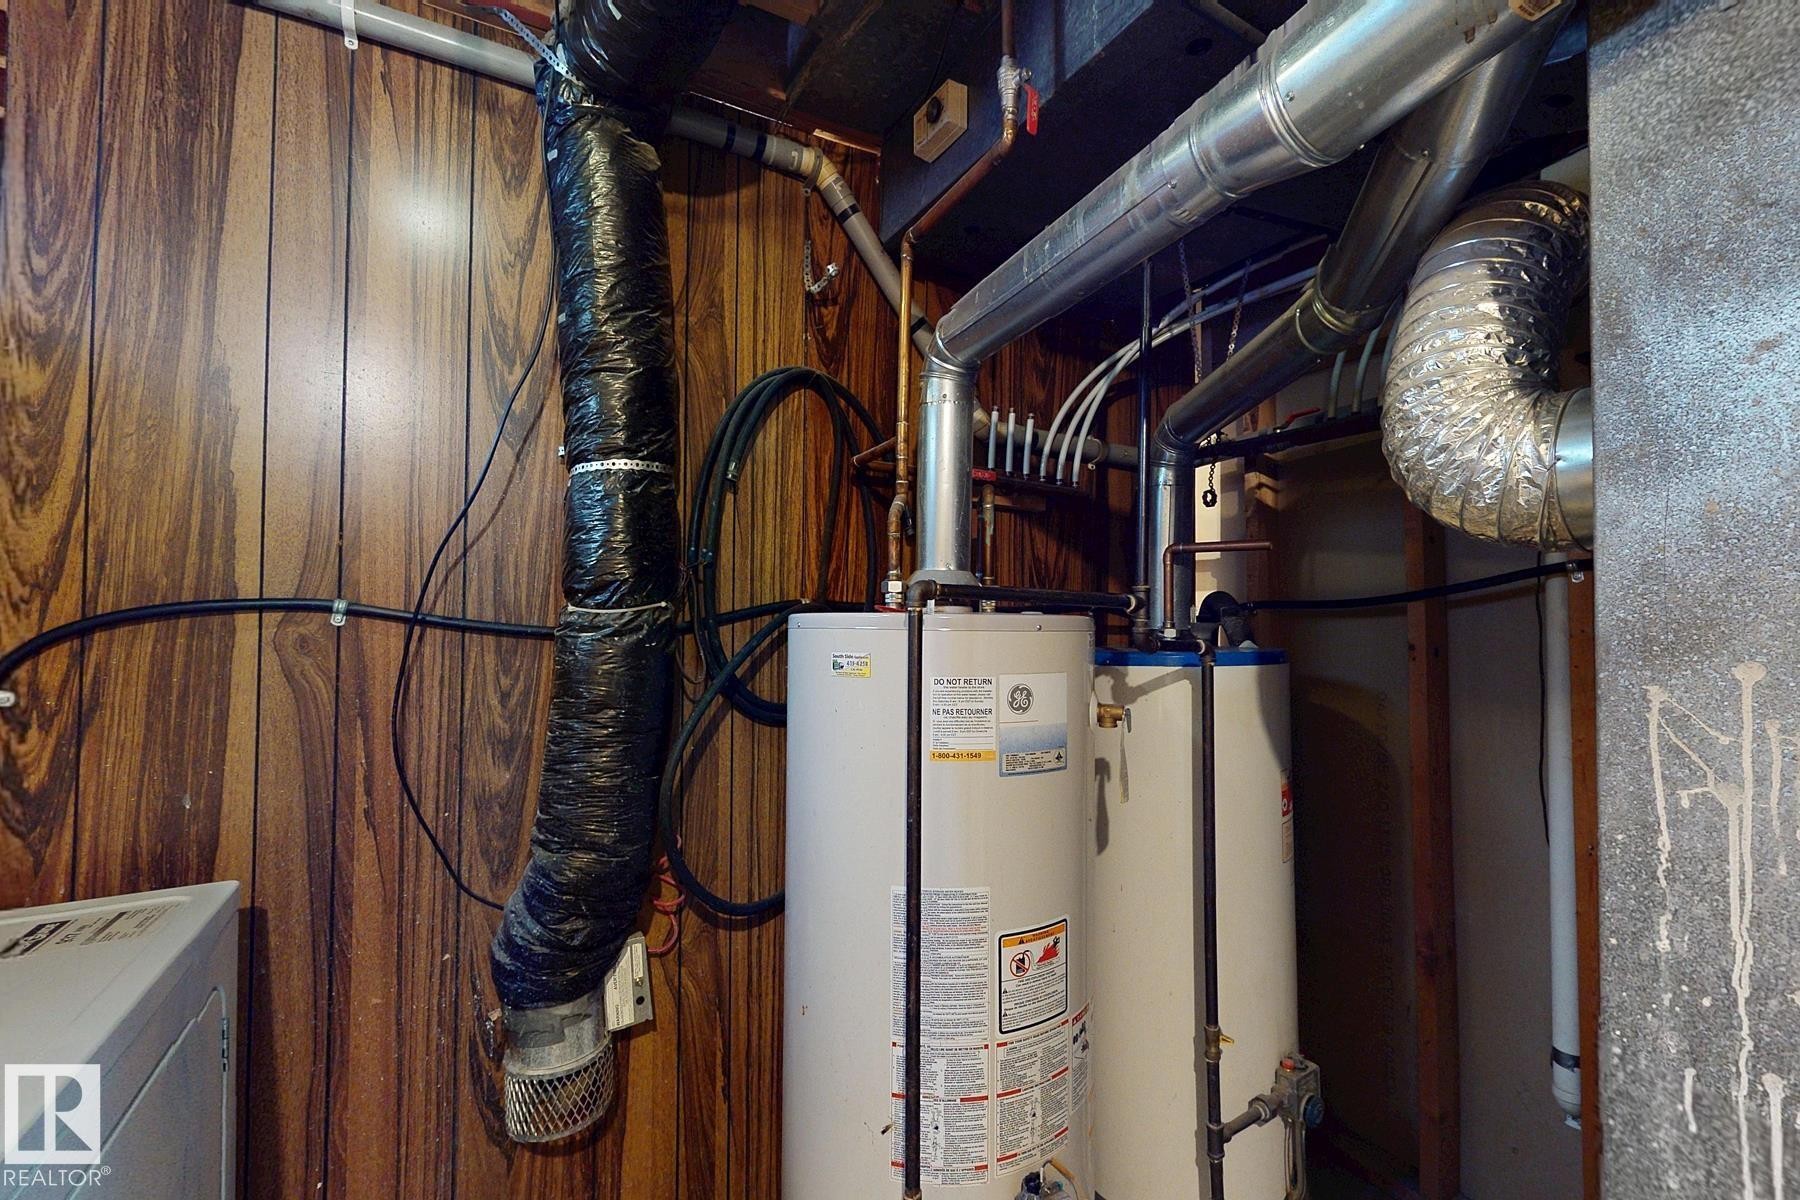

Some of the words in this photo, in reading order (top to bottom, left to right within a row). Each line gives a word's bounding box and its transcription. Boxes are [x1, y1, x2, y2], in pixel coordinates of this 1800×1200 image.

[933, 678, 945, 686] DO
[946, 678, 962, 686] NOT
[963, 678, 993, 686] RETURN
[932, 708, 941, 716] NE
[942, 708, 955, 716] PAS
[955, 708, 993, 716] RETOURNER
[931, 752, 982, 760] 1-800-431-1549
